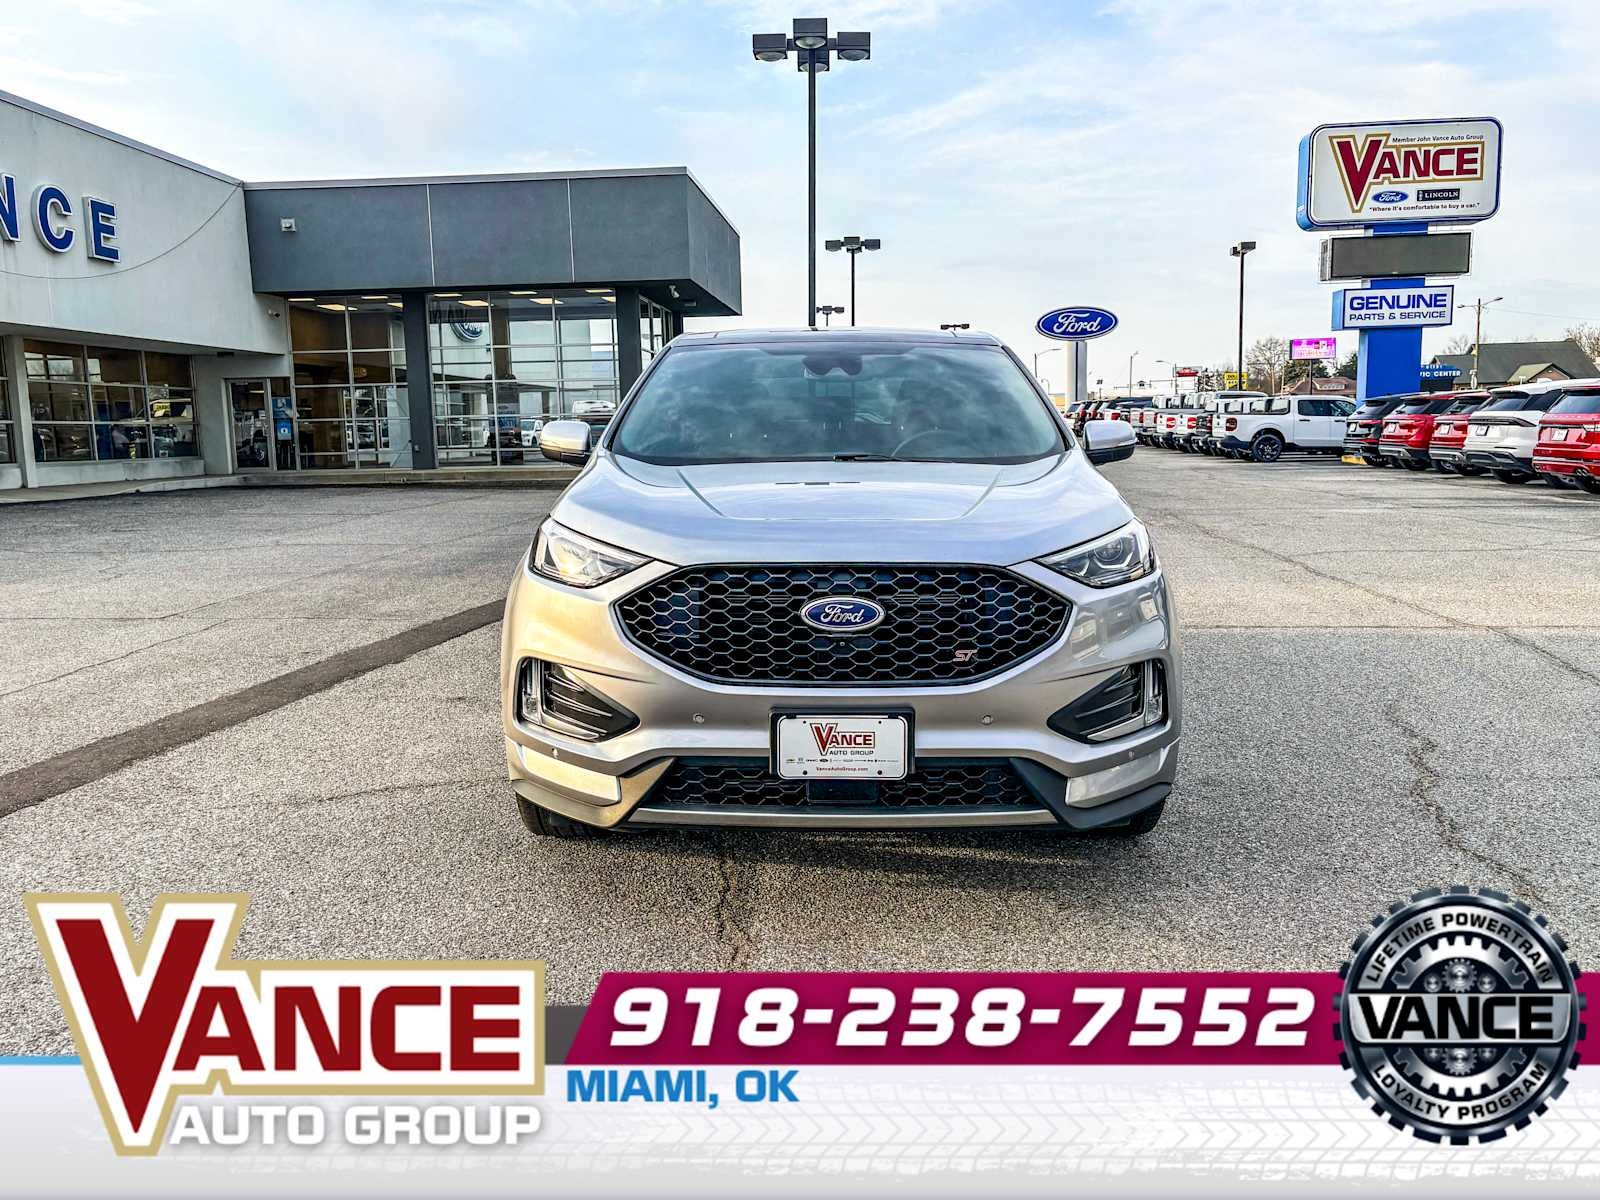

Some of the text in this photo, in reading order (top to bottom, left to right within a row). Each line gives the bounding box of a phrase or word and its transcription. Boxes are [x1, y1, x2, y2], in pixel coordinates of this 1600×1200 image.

[1336, 139, 1480, 207] VANCE
[1424, 191, 1459, 199] LINCOLN
[1349, 293, 1448, 311] GENUINE
[1053, 312, 1102, 333] Ford
[1349, 311, 1446, 321] PARTS & SERVICE
[820, 603, 865, 623] Ford
[952, 649, 978, 662] ST
[813, 725, 873, 753] VANCE
